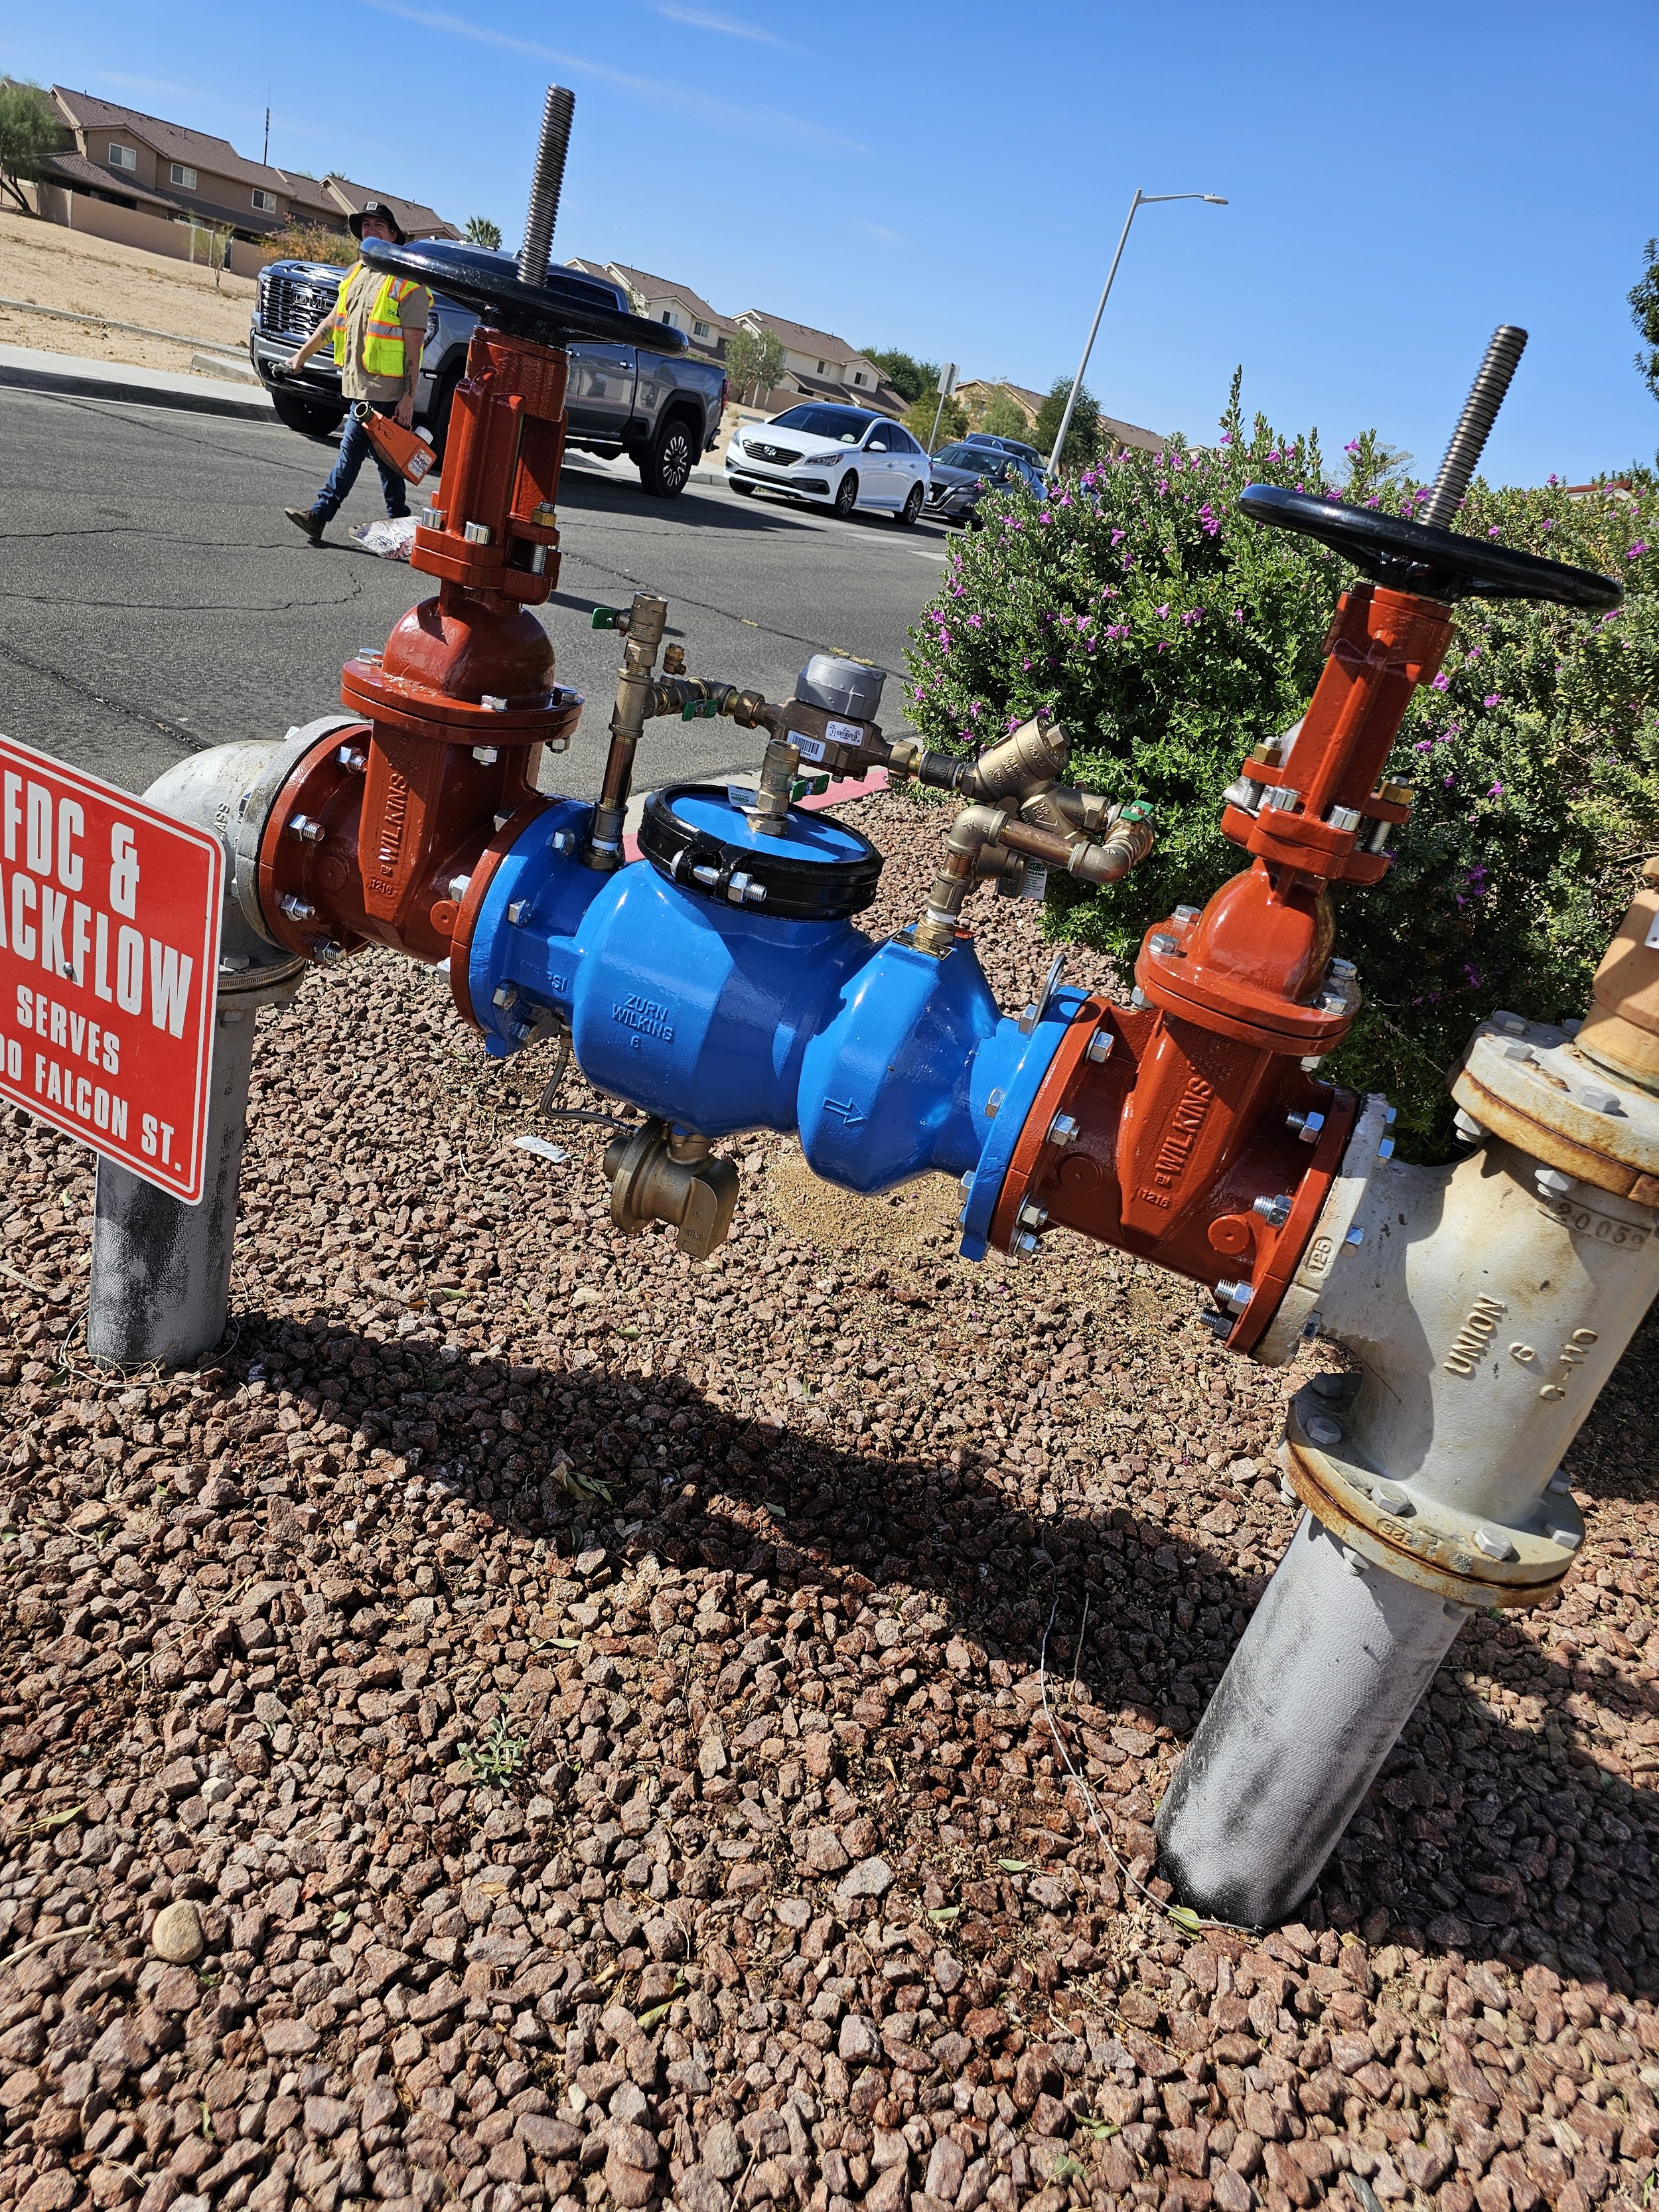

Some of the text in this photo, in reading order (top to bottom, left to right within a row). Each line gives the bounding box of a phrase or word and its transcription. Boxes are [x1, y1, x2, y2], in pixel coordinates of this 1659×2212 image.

[291, 292, 334, 311] GMC
[1001, 759, 1018, 781] ZURN
[1007, 752, 1027, 780] WILKINS
[4, 769, 139, 921] FDC &
[378, 773, 407, 865] WILKINS
[1028, 863, 1045, 871] ZURN
[0, 863, 193, 1039] CKFLOW
[17, 984, 120, 1075] SERVES
[612, 1003, 675, 1043] WILKINS
[624, 993, 669, 1023] ZURN
[630, 1035, 641, 1049] 6
[35, 1053, 128, 1142] FALCON
[141, 1113, 181, 1172] ST.
[1155, 1076, 1214, 1175] WILKINS
[1308, 1240, 1331, 1272] 125
[1443, 1292, 1506, 1374] UNION
[1539, 1328, 1599, 1402] C-110
